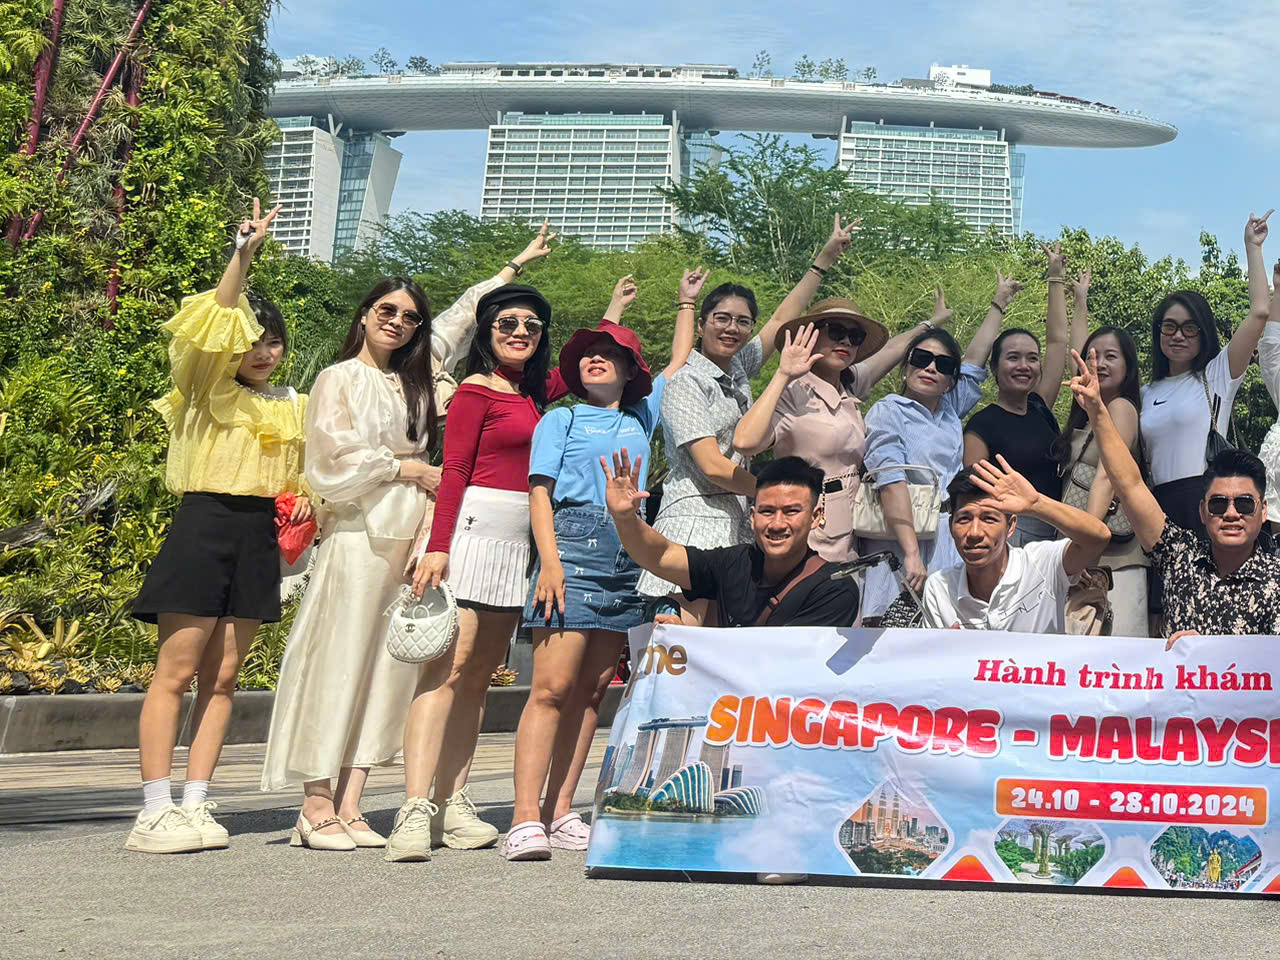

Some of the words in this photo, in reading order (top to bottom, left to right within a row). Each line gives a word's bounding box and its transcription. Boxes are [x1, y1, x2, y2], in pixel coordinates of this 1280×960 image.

[973, 658, 1067, 687] Hành
[1078, 662, 1164, 690] trình
[1175, 663, 1273, 691] khám
[704, 694, 1002, 755] SINGAPORE
[1012, 728, 1037, 743] -
[1011, 787, 1080, 811] 24.10
[1089, 799, 1100, 807] -
[1109, 791, 1256, 817] 28.10.2024
